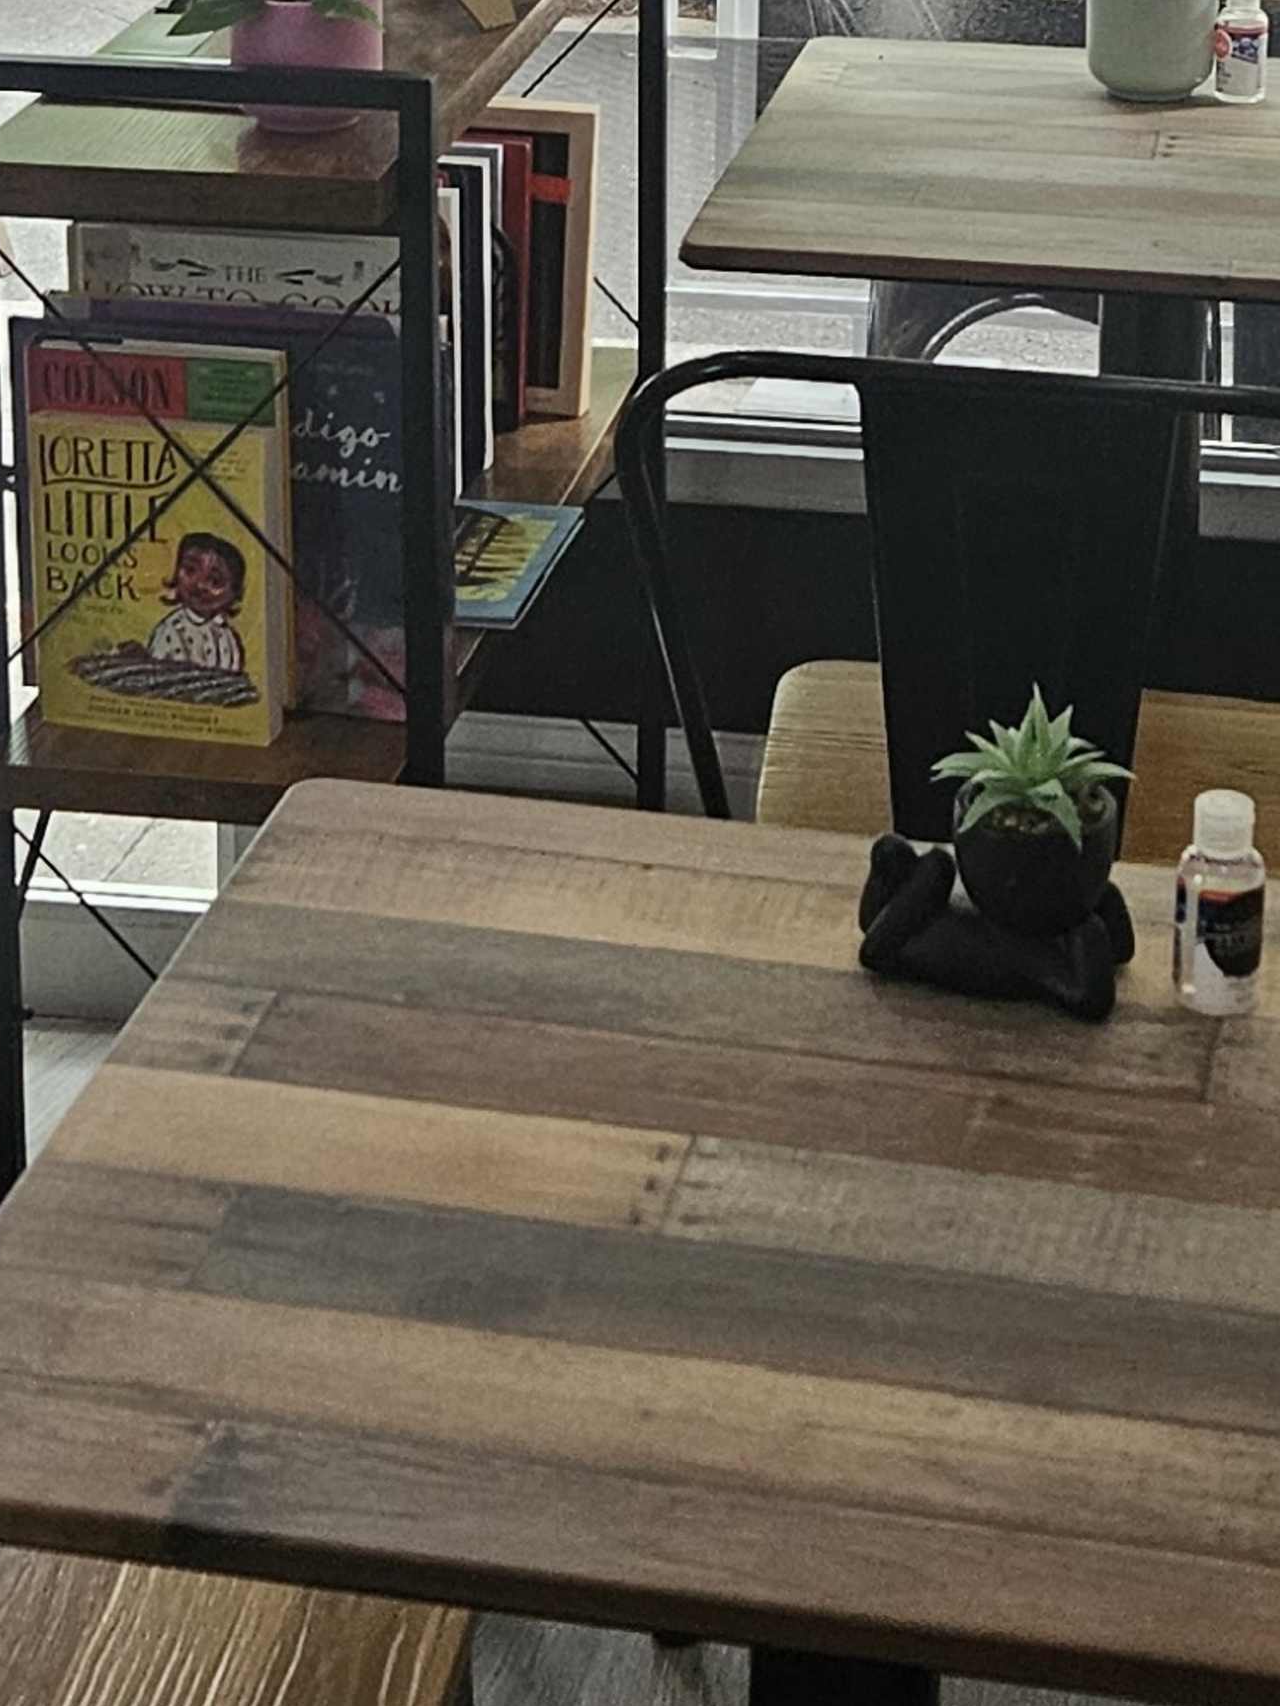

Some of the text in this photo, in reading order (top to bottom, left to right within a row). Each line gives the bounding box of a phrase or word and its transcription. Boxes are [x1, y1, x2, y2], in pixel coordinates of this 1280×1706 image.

[224, 265, 267, 284] THE
[39, 433, 178, 486] LORETTA
[44, 489, 170, 545] LITTLE
